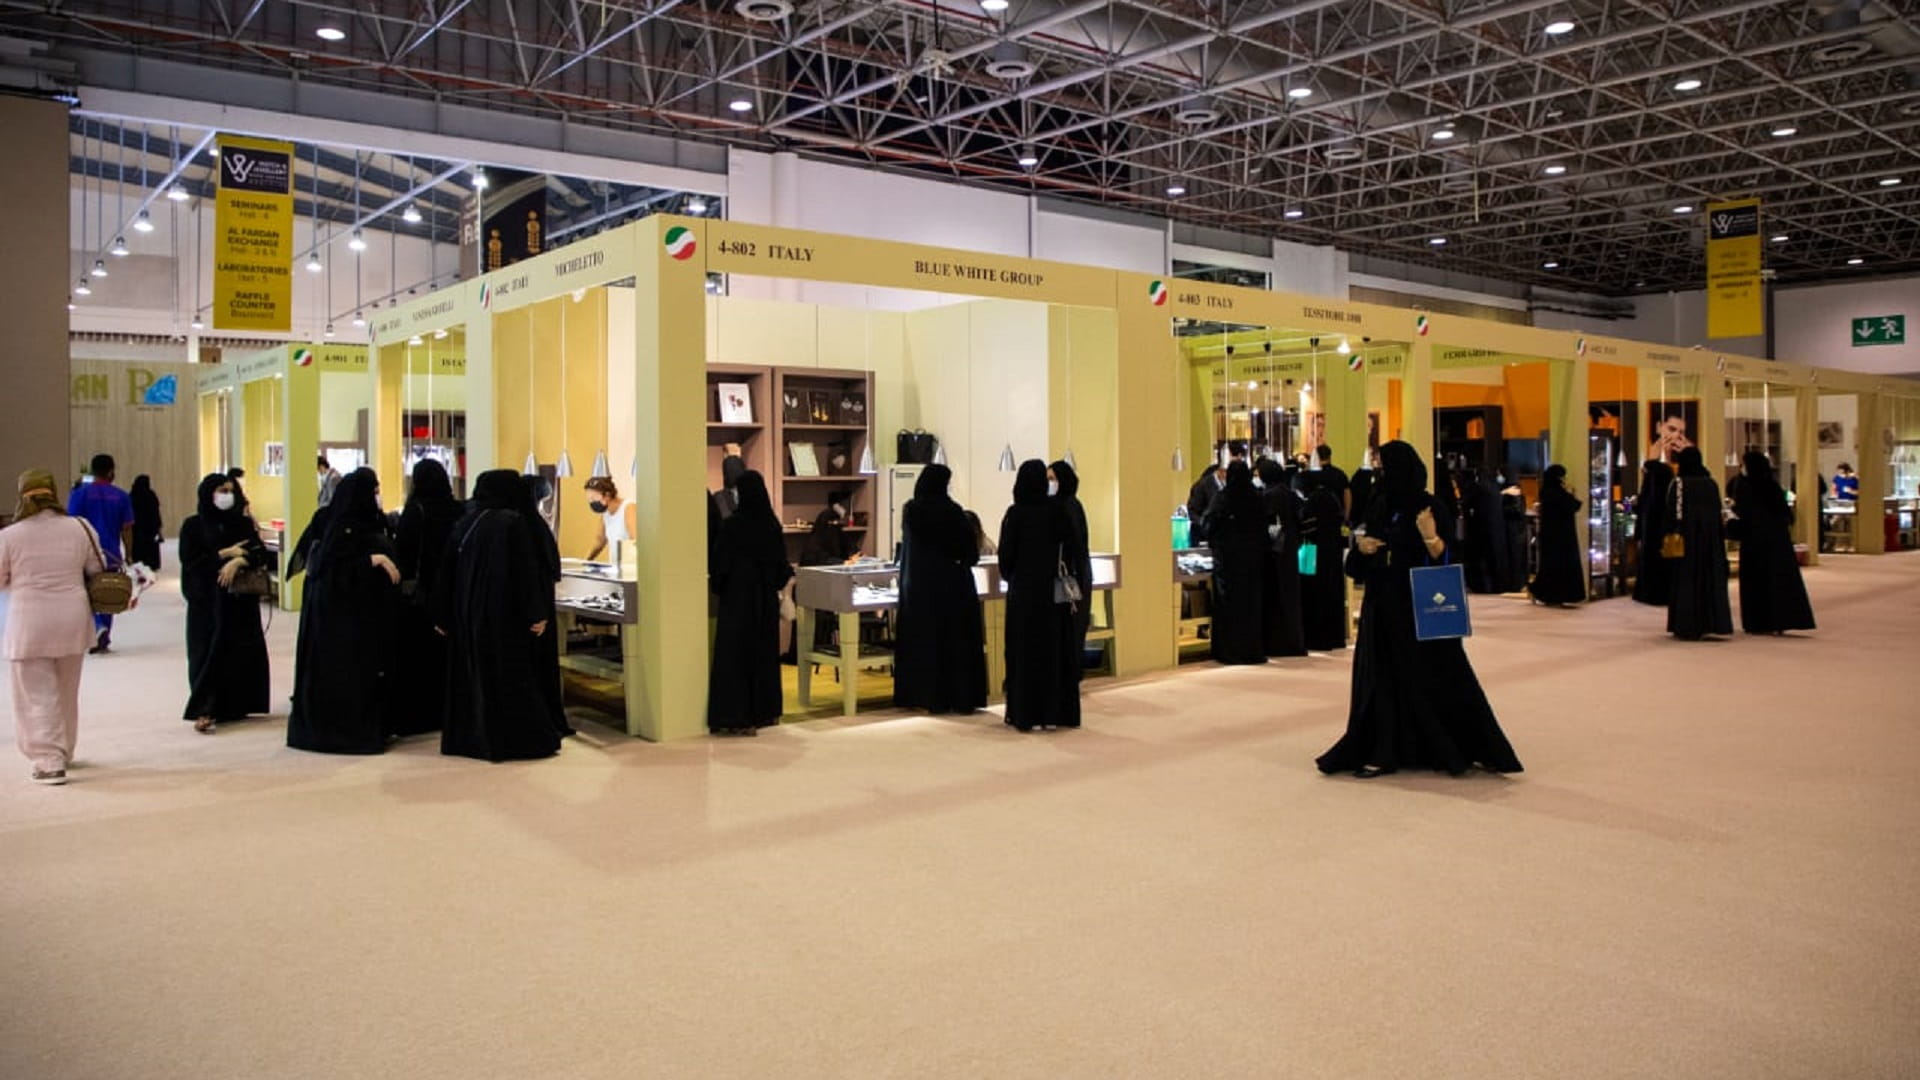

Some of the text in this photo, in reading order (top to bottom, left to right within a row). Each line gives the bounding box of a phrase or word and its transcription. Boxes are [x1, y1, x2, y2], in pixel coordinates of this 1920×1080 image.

[718, 239, 815, 261] 4-802 ITALY
[217, 263, 288, 275] LABORATORIES
[914, 260, 1043, 286] BLUE WHITE GROUP
[230, 300, 276, 309] COUNTER
[1207, 295, 1233, 309] ITALY
